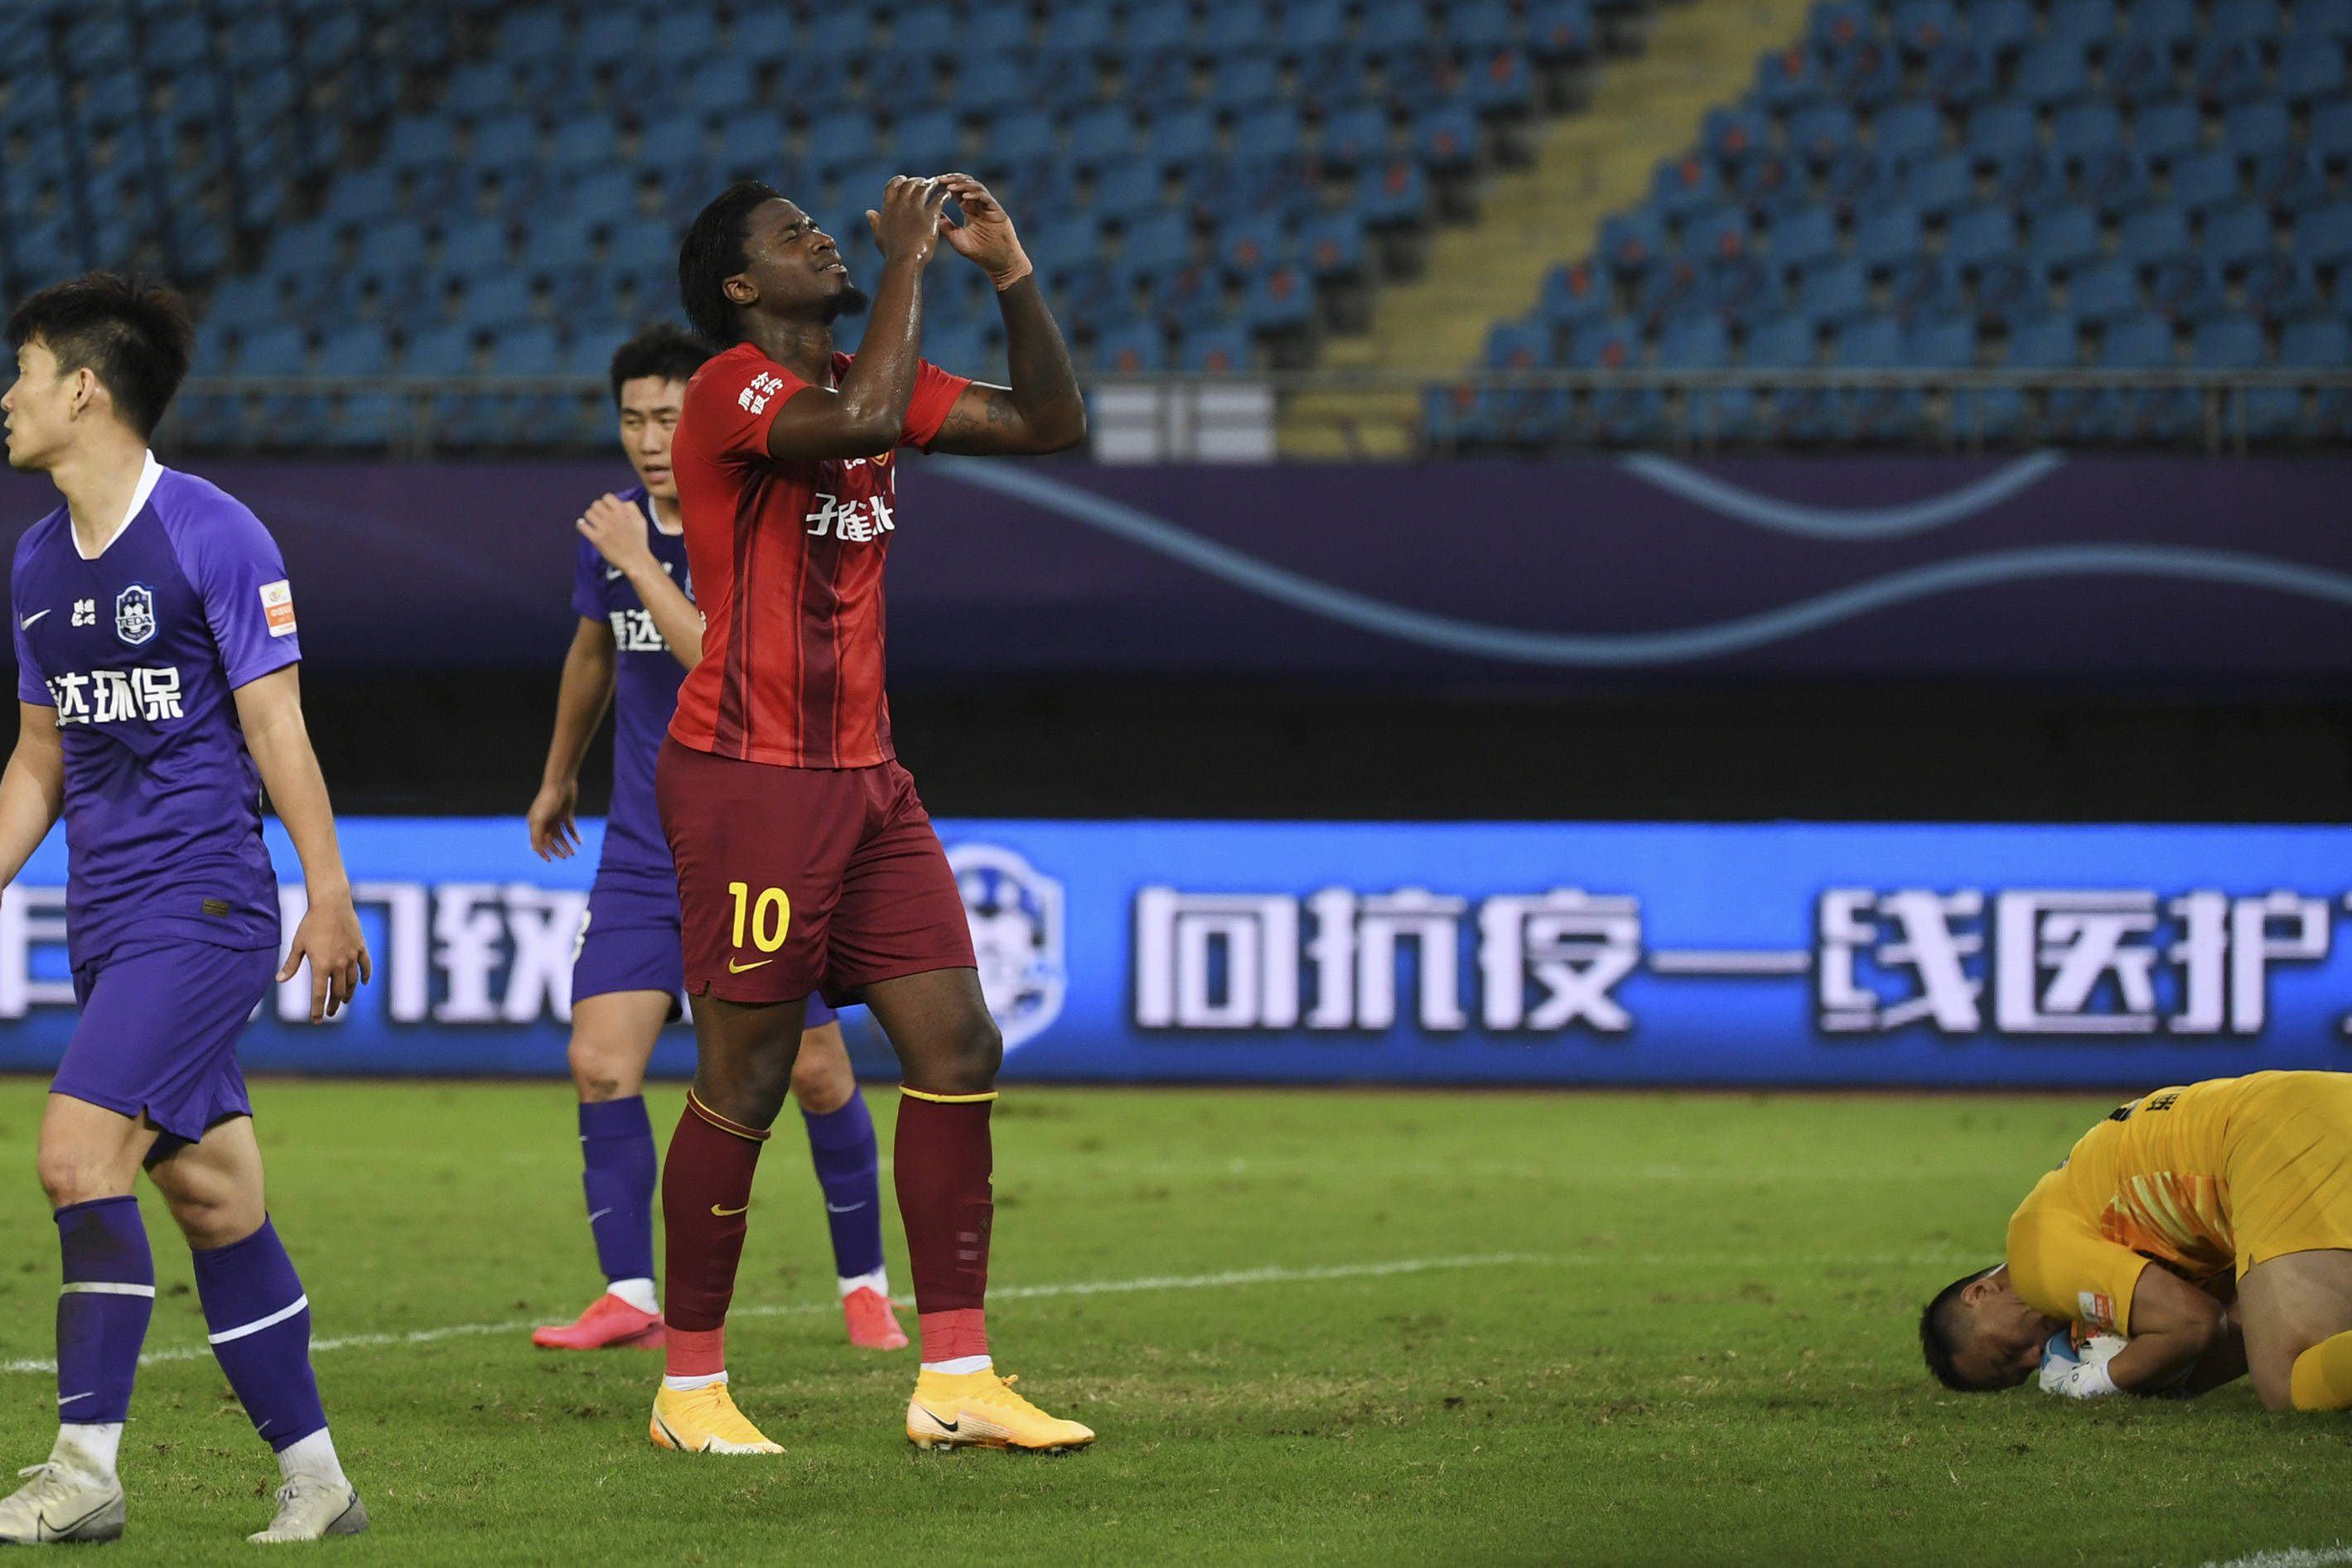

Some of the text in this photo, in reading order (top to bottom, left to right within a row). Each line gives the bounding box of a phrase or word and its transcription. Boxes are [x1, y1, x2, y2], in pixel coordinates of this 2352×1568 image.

[116, 615, 153, 628] TEDA
[46, 666, 184, 726] 达环保
[728, 881, 790, 953] 10
[1135, 887, 2352, 1034] 向抗疫一线医护
